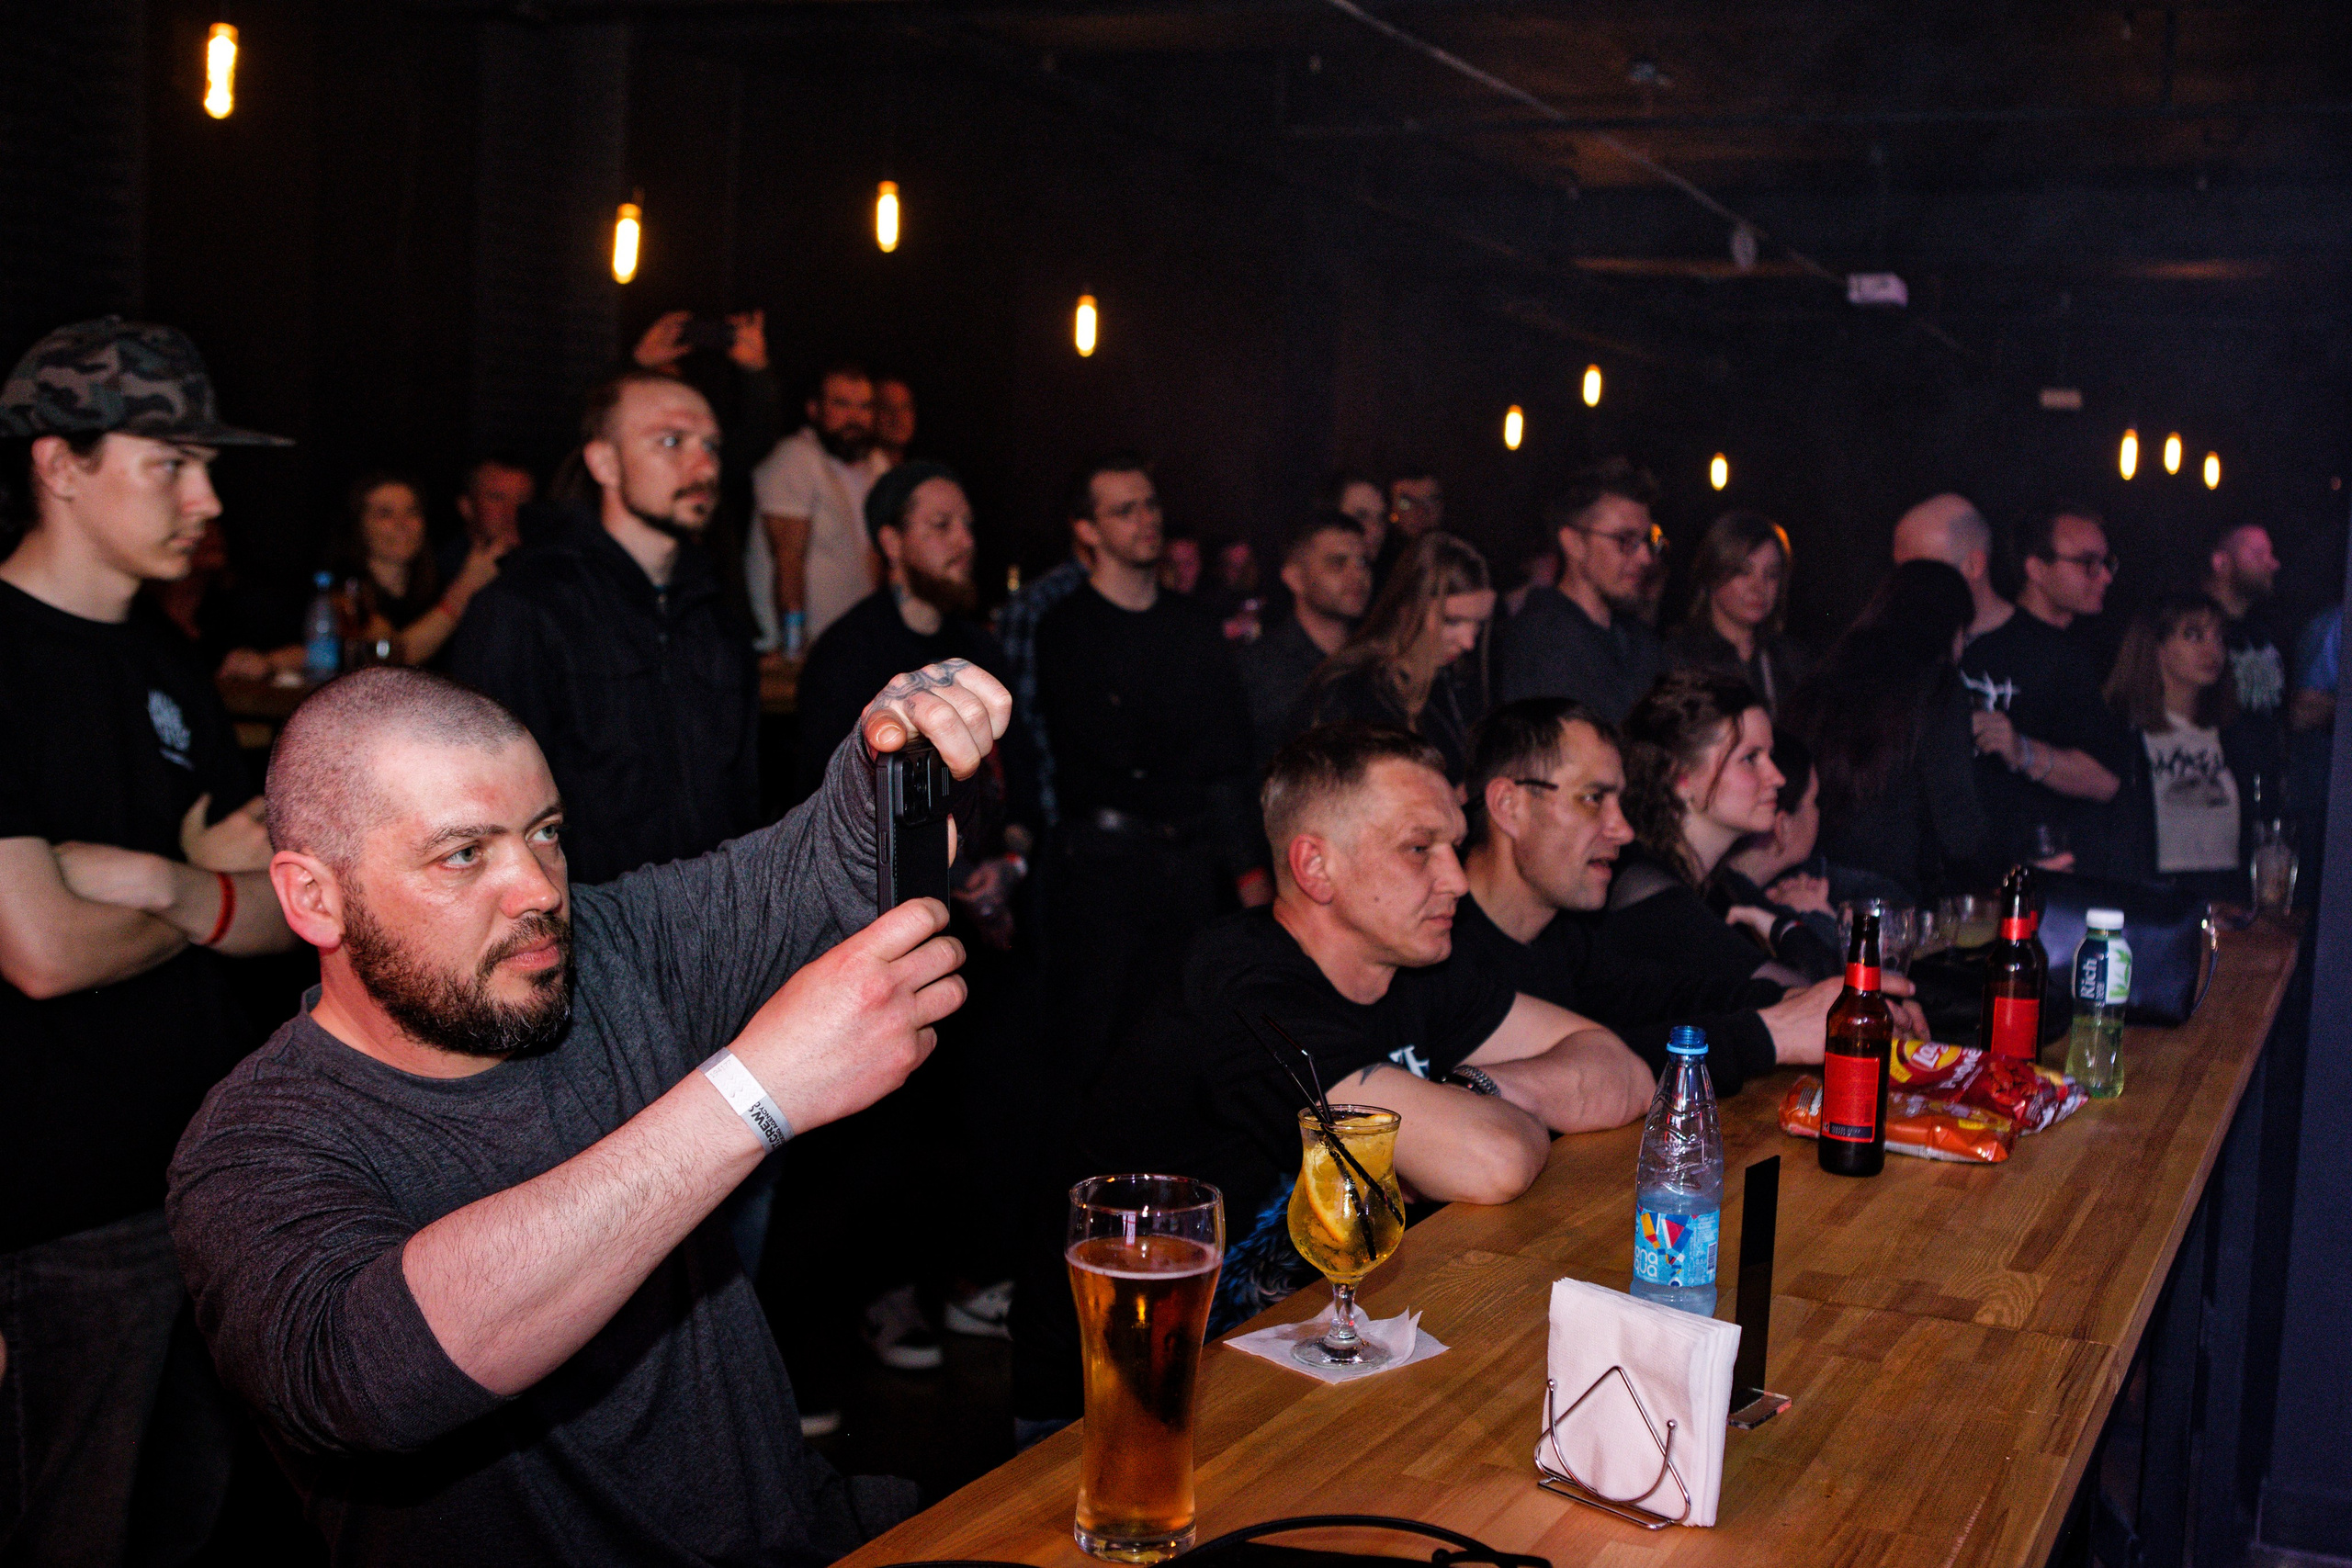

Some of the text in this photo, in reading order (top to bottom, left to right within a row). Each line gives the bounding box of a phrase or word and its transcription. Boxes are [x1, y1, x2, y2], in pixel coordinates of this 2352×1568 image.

[2080, 957, 2098, 998] Rich
[758, 1106, 778, 1129] AGENCY
[751, 1111, 782, 1148] T.CREW
[1635, 1245, 1658, 1265] ona
[1635, 1258, 1658, 1278] qua
